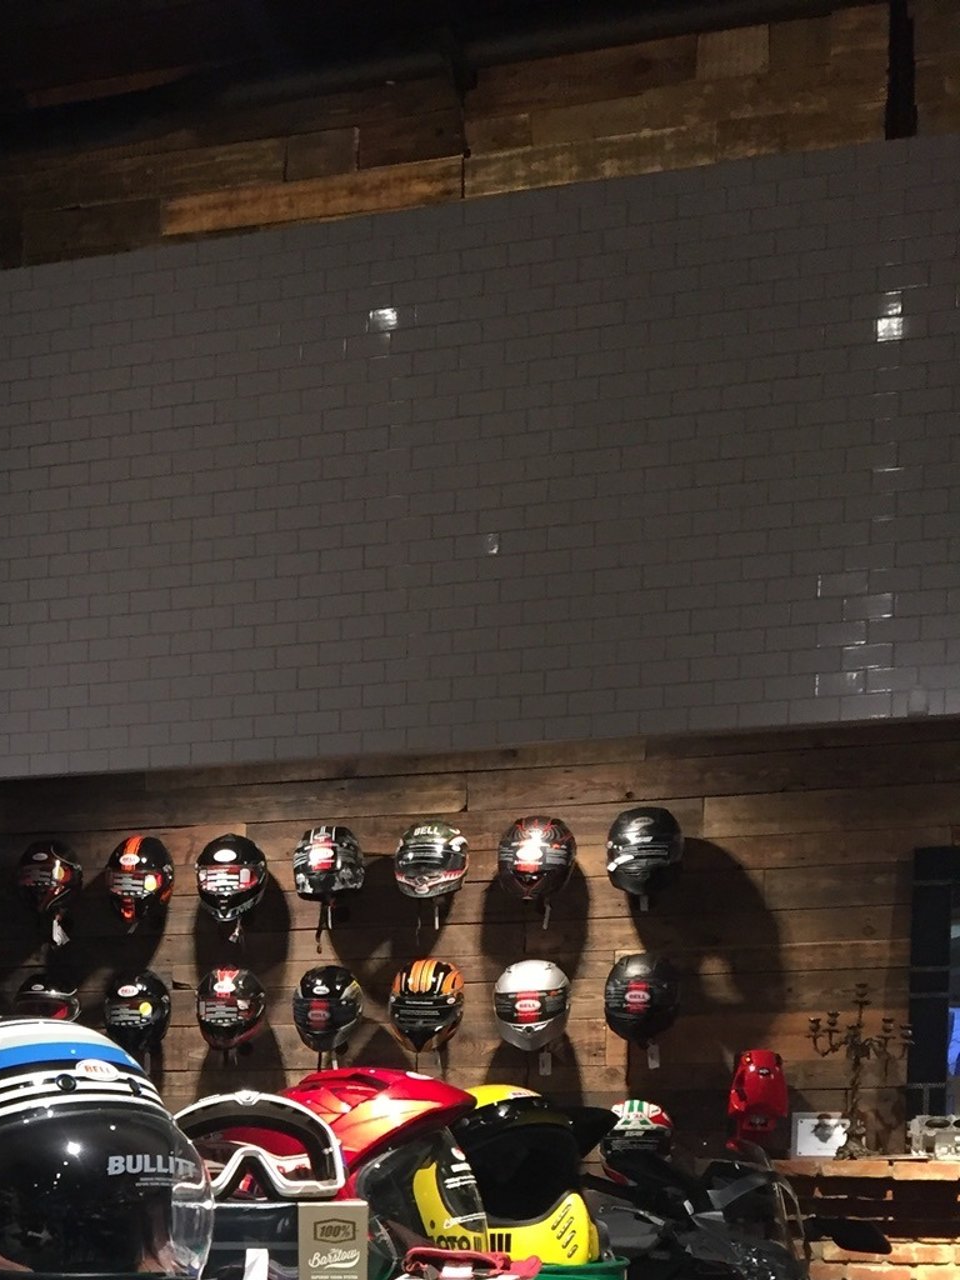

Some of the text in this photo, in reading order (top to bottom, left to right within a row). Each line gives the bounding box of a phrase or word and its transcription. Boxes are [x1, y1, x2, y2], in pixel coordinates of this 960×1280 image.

[413, 826, 441, 837] BELL
[84, 1064, 112, 1075] BELL
[106, 1154, 197, 1177] BULLITT
[319, 1224, 351, 1238] 100%
[308, 1248, 360, 1269] Barstow
